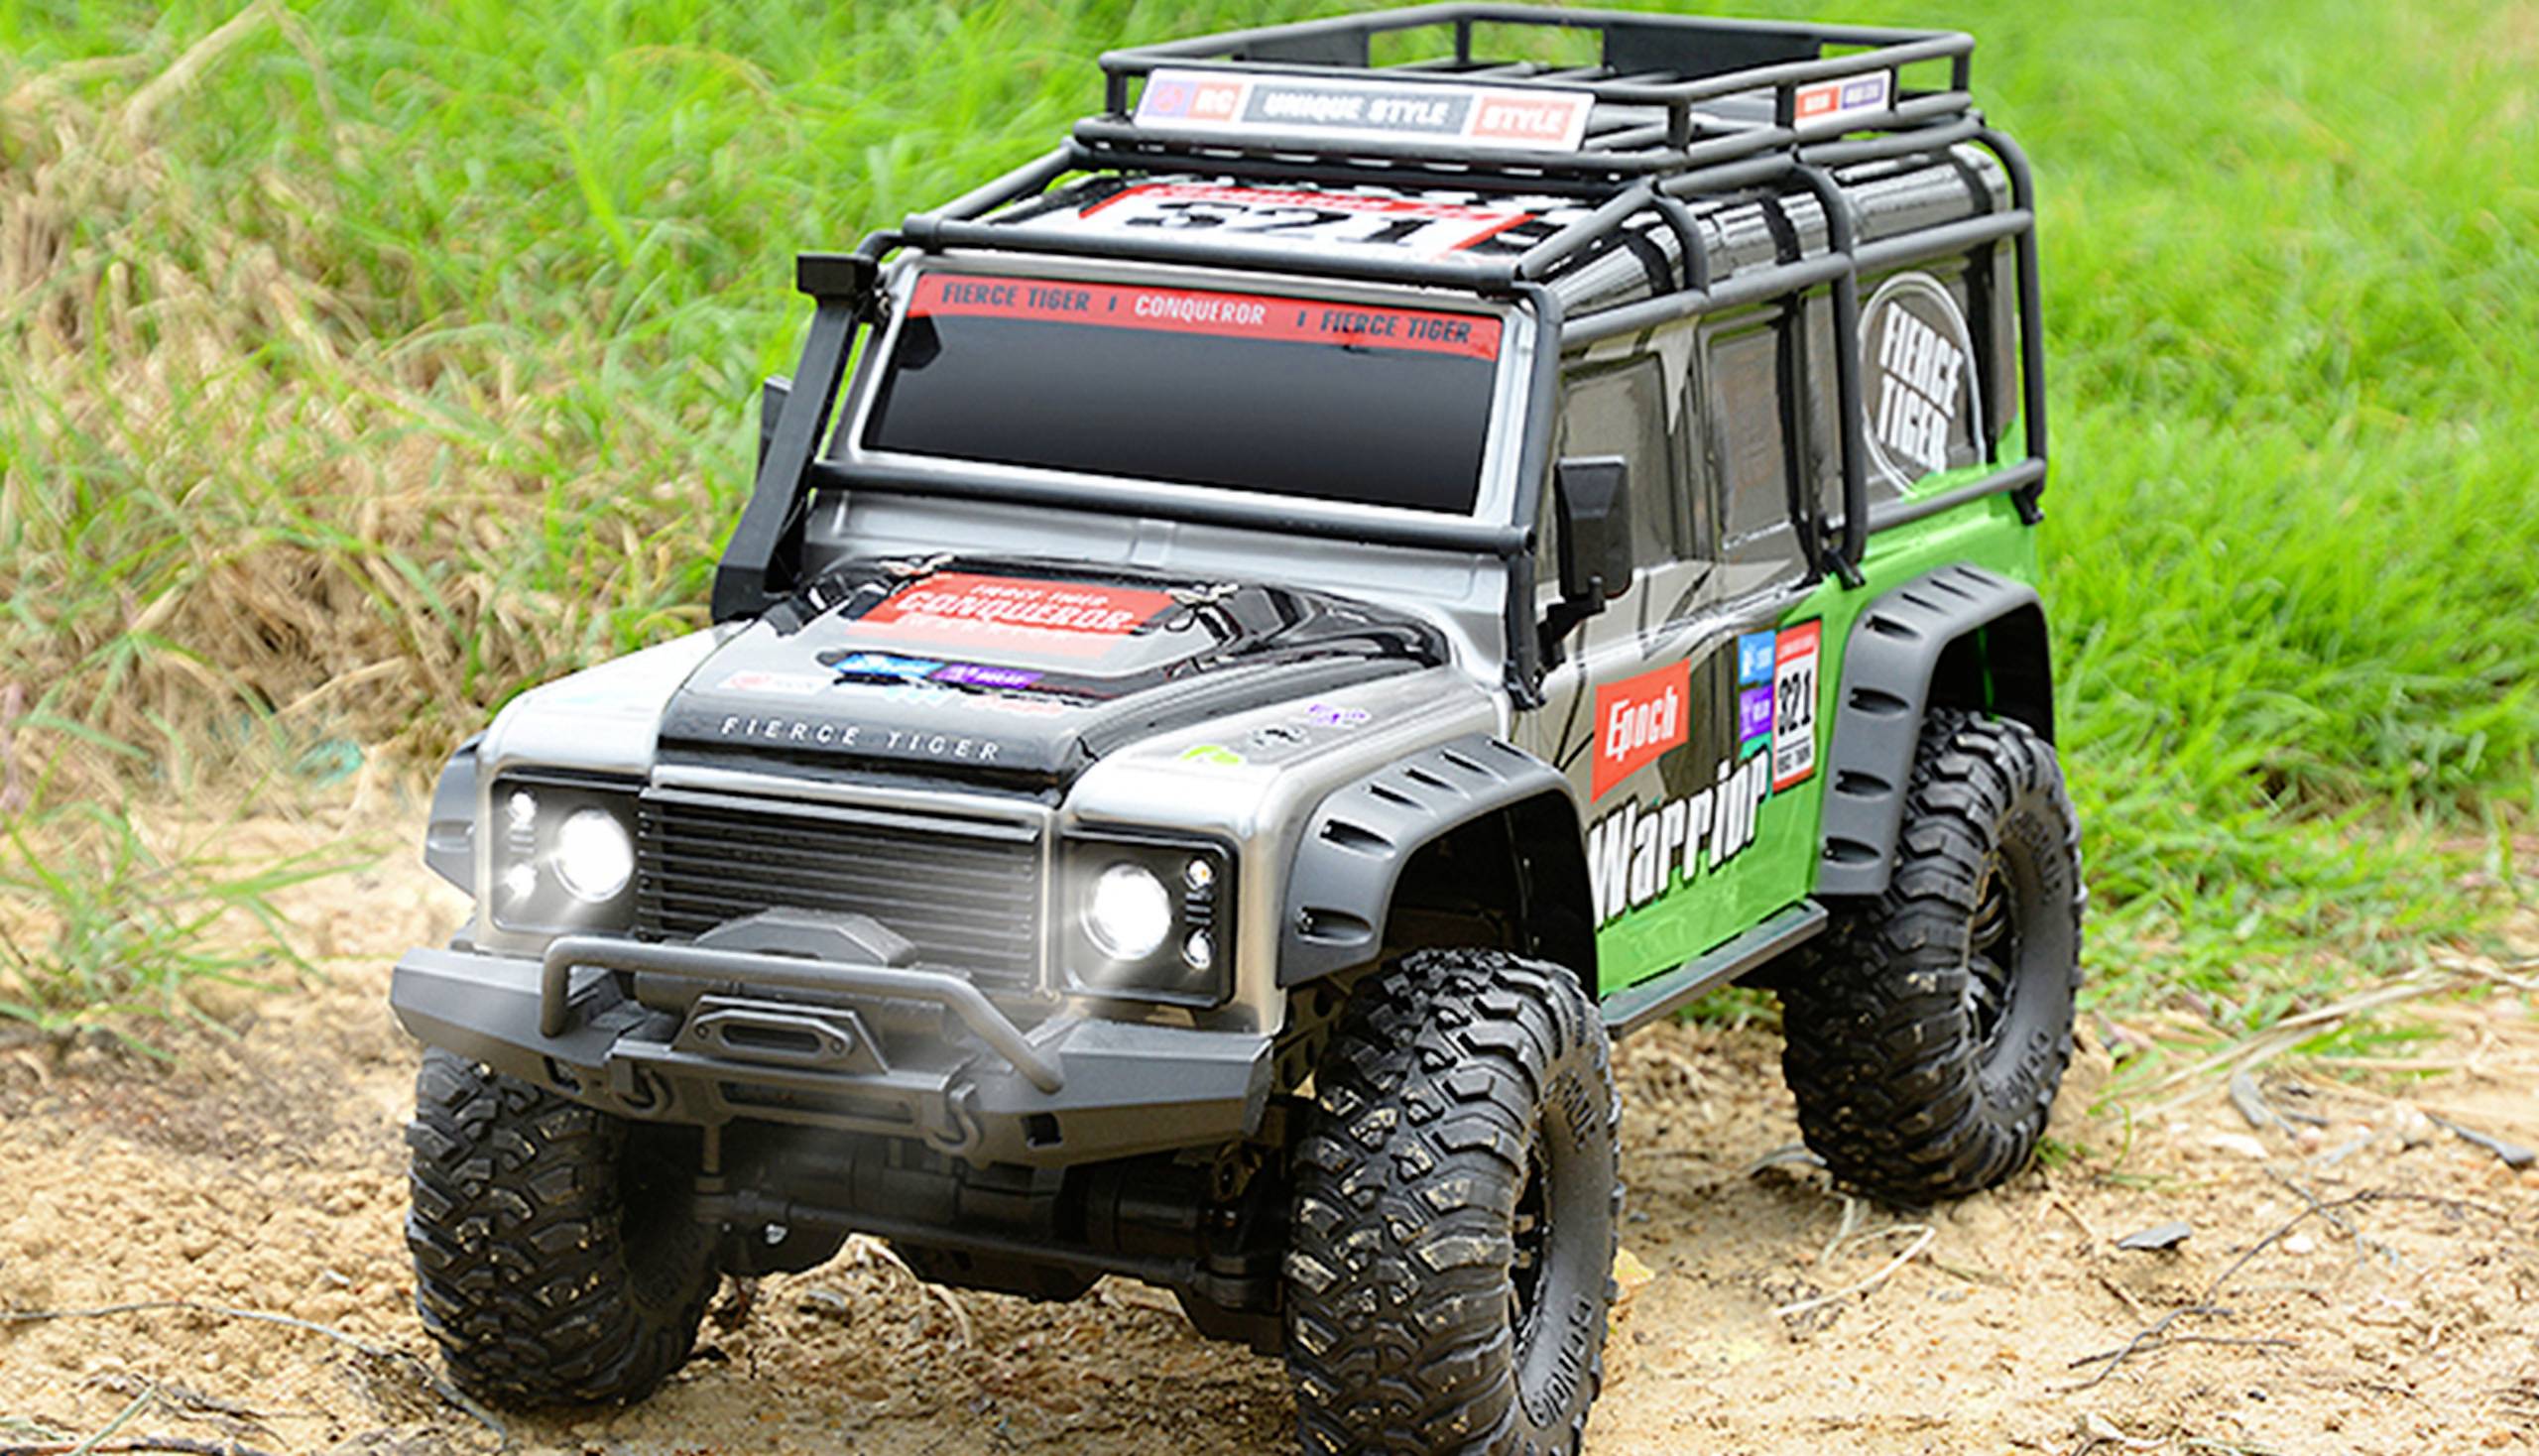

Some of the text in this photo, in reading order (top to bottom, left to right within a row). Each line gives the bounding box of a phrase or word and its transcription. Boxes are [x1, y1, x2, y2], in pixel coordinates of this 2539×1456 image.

[1264, 91, 1360, 120] UNIQUE
[1368, 97, 1449, 126] STYLE
[1482, 104, 1564, 133] STYLE
[941, 283, 1472, 344] FIERCE TIGER CONQUEROR FIERCE TIGER
[1877, 300, 1965, 420] FIERCE
[1876, 374, 1949, 476] TIGER
[896, 591, 1136, 632] CONQUEROR
[1605, 684, 1679, 762] Epoch
[1776, 667, 1812, 737] 321
[721, 716, 1001, 761] FIERCE TIGER
[1588, 749, 1769, 932] Warrior
